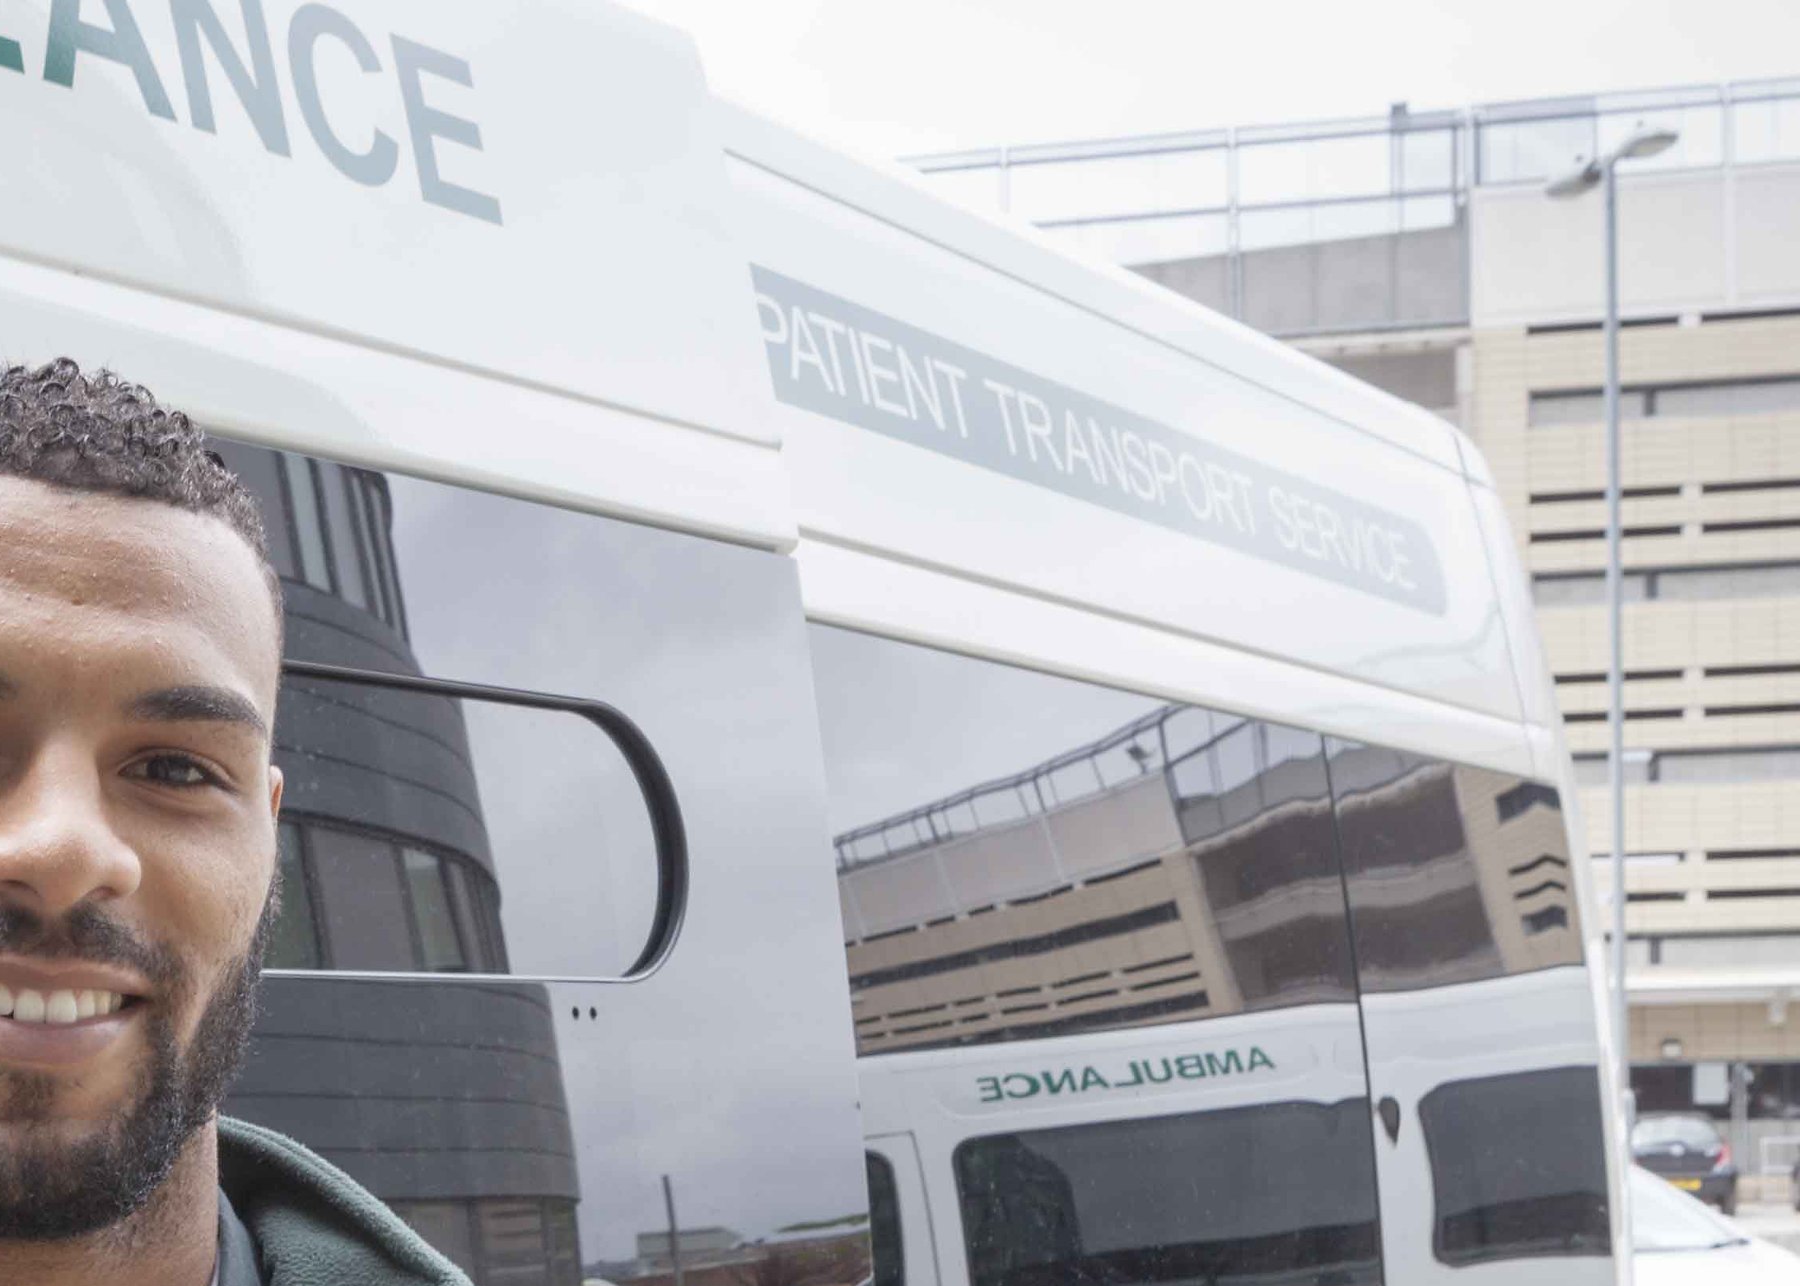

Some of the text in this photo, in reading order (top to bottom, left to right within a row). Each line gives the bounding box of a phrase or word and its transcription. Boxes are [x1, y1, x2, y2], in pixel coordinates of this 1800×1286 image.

[756, 298, 1416, 592] PATIENT TRANSPORT SERVICE
